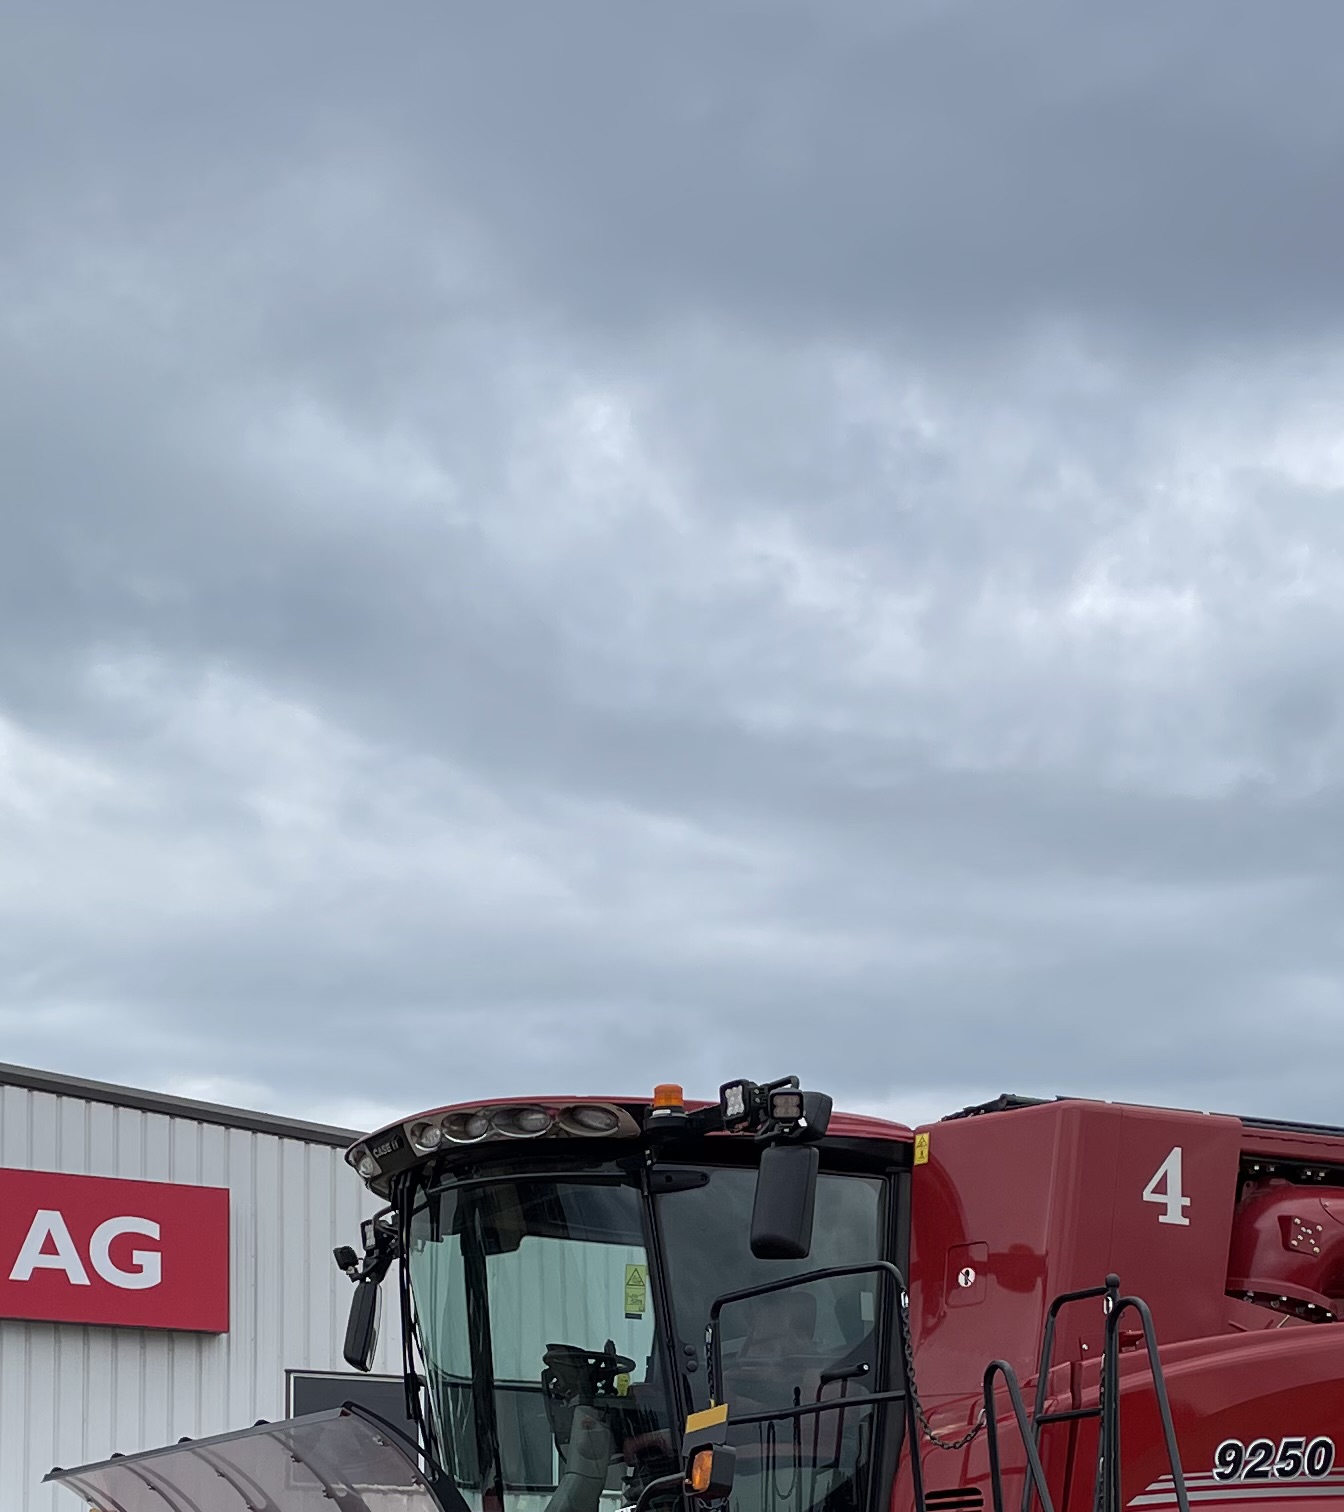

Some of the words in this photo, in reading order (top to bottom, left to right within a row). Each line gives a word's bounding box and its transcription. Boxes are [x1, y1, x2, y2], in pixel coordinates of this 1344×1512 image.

[1142, 1146, 1191, 1226] 4
[9, 1208, 163, 1290] AG
[1212, 1436, 1336, 1482] 9250
